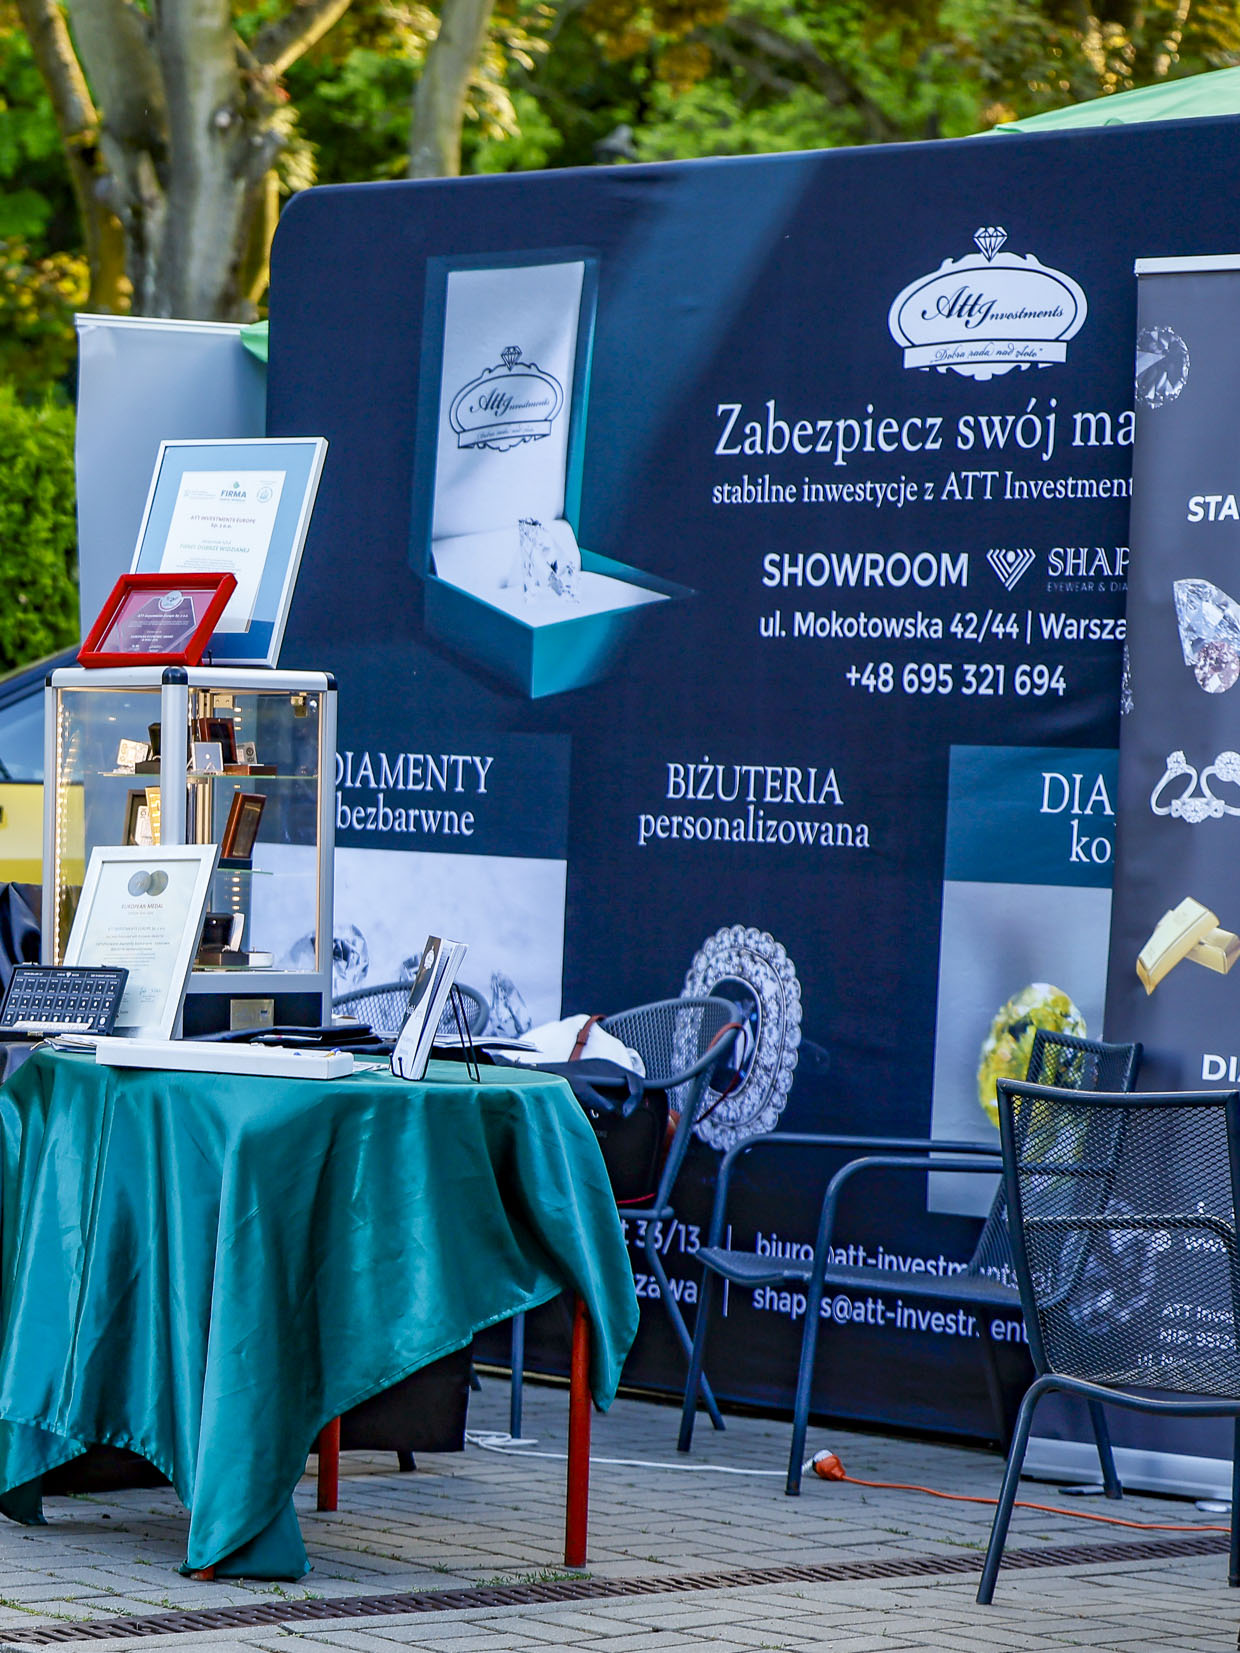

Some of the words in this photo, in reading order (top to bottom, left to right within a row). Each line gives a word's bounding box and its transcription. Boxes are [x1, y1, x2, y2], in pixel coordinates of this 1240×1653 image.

[714, 400, 942, 466] Zabezpiecz
[957, 397, 1058, 461] swój
[220, 489, 247, 498] FIRMA
[712, 473, 797, 504] stabilne
[801, 474, 918, 508] inwestycje
[923, 482, 934, 500] z
[940, 471, 1000, 501] ATT
[762, 551, 969, 588] SHOWROOM
[1047, 547, 1130, 577] SHAP
[1047, 581, 1094, 593] EYEWEAR
[1098, 582, 1106, 592] &
[760, 610, 786, 637] ul.
[793, 610, 943, 640] Mokotowska
[950, 608, 1020, 643] 42/44
[1039, 613, 1127, 641] Warsza
[846, 662, 894, 694] +48
[902, 663, 954, 695] 695
[962, 664, 1005, 696] 321
[1014, 664, 1067, 697] 694
[665, 754, 845, 805] BIŻUTERIA
[1040, 772, 1115, 815] DIA
[336, 790, 475, 836] bezbarwne
[637, 803, 871, 848] personalizowana
[1069, 818, 1117, 864] ko
[1202, 1053, 1240, 1082] DI
